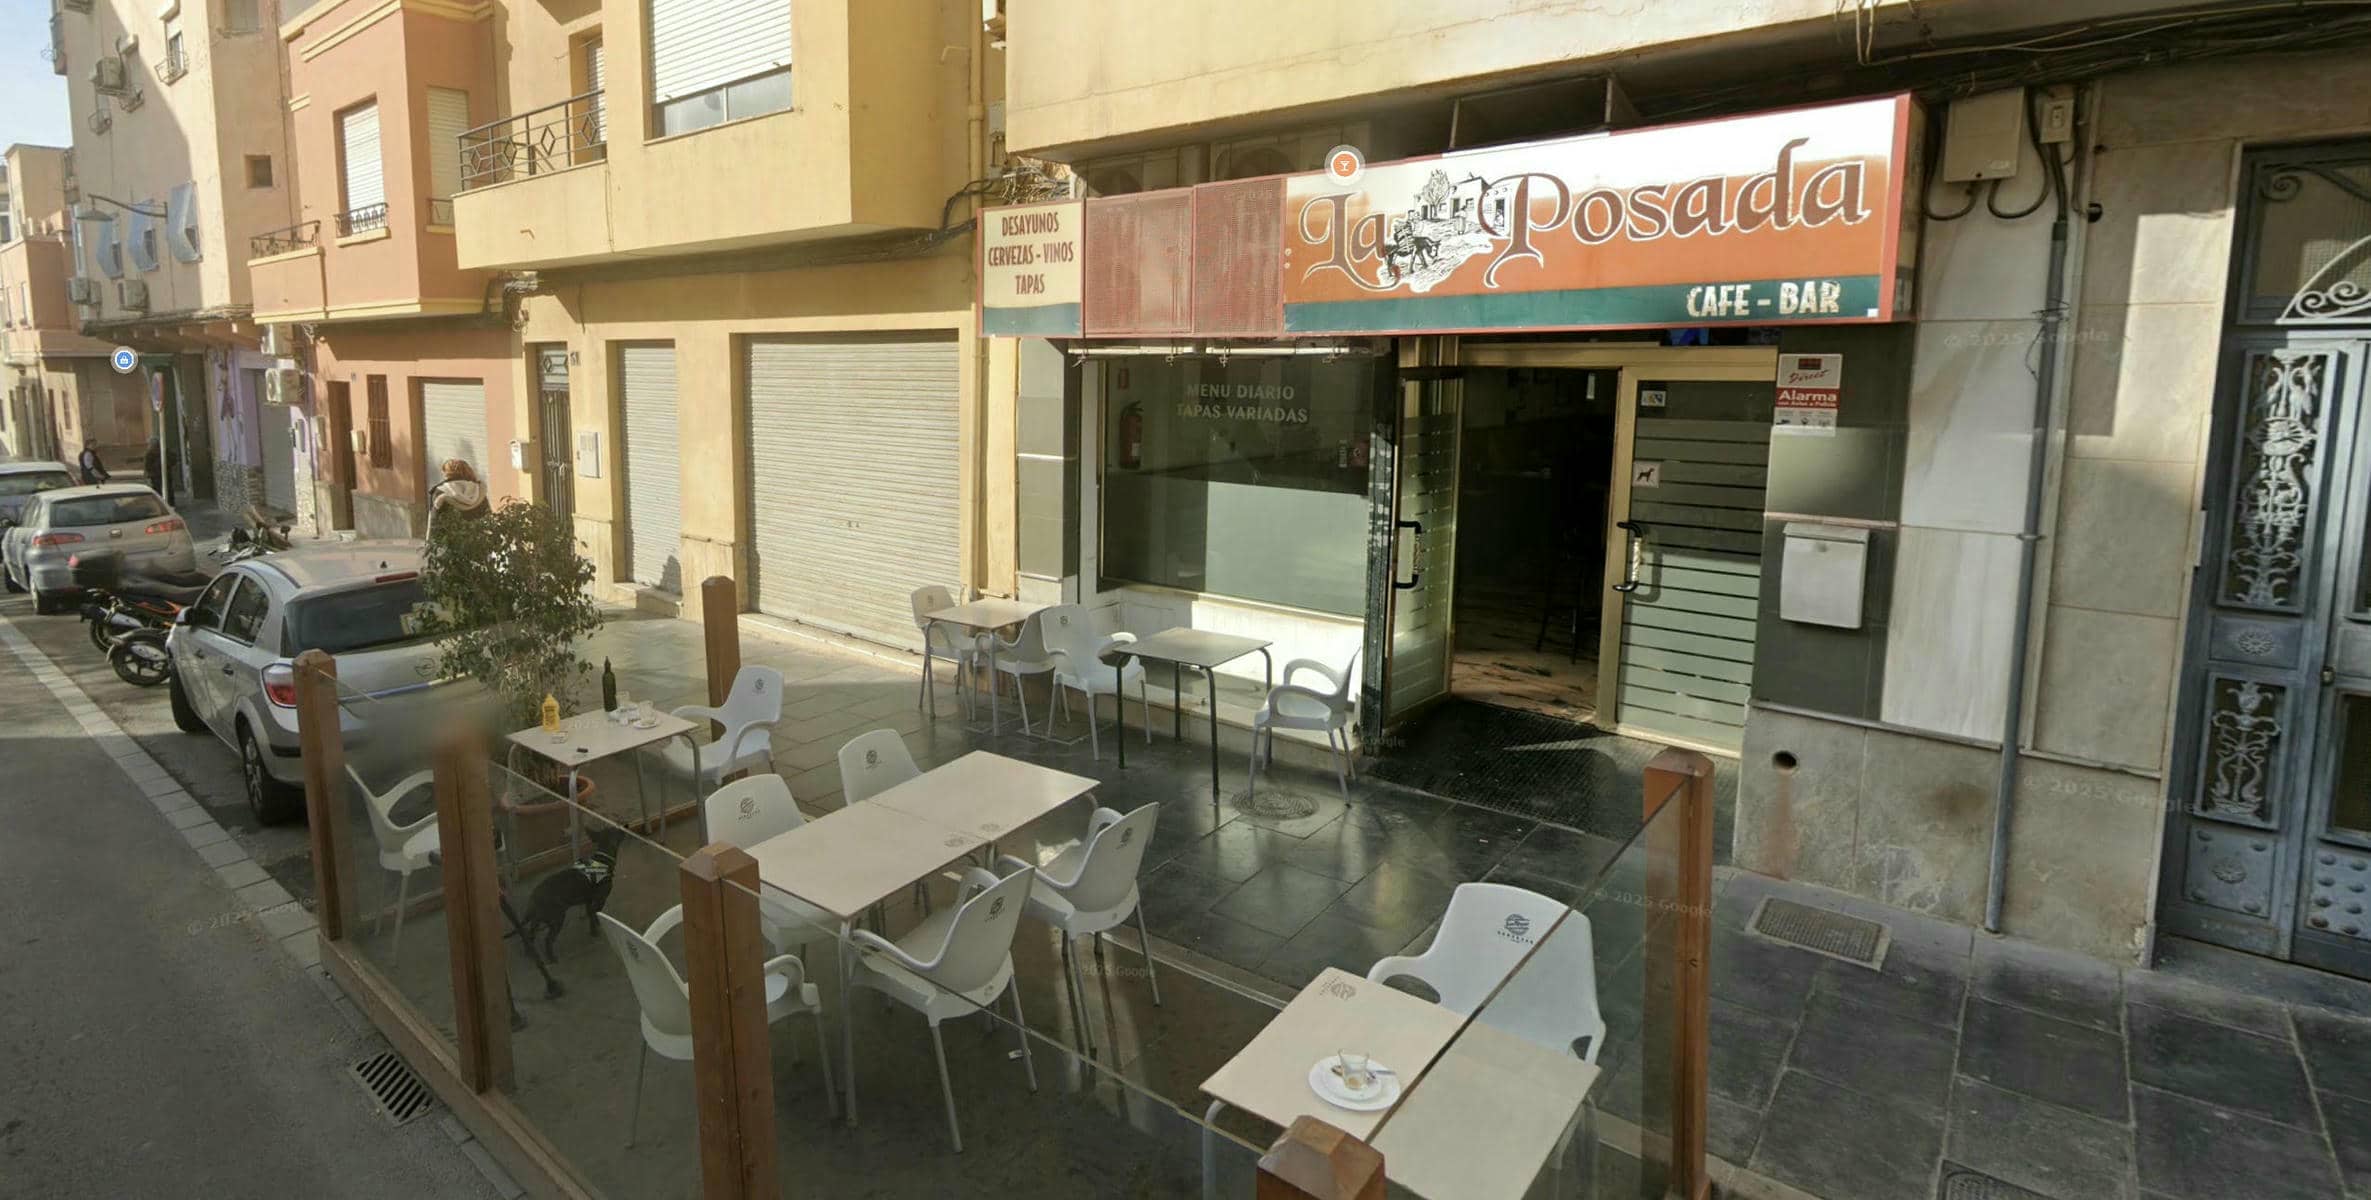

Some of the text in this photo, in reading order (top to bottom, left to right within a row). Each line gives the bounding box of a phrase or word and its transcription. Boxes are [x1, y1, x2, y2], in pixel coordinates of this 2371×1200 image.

[1001, 211, 1060, 237] DESAYUNOS
[1299, 137, 1872, 292] La Posada
[988, 245, 1035, 267] CERVEZAS
[1043, 241, 1074, 264] VINOS
[1015, 275, 1046, 295] TAPAS
[1685, 283, 1752, 319] CAFE
[1778, 279, 1842, 316] BAR
[1187, 383, 1295, 400] MENU DIARIO
[1779, 389, 1837, 402] Alarma
[1177, 403, 1308, 424] TAPAS VARIADAS
